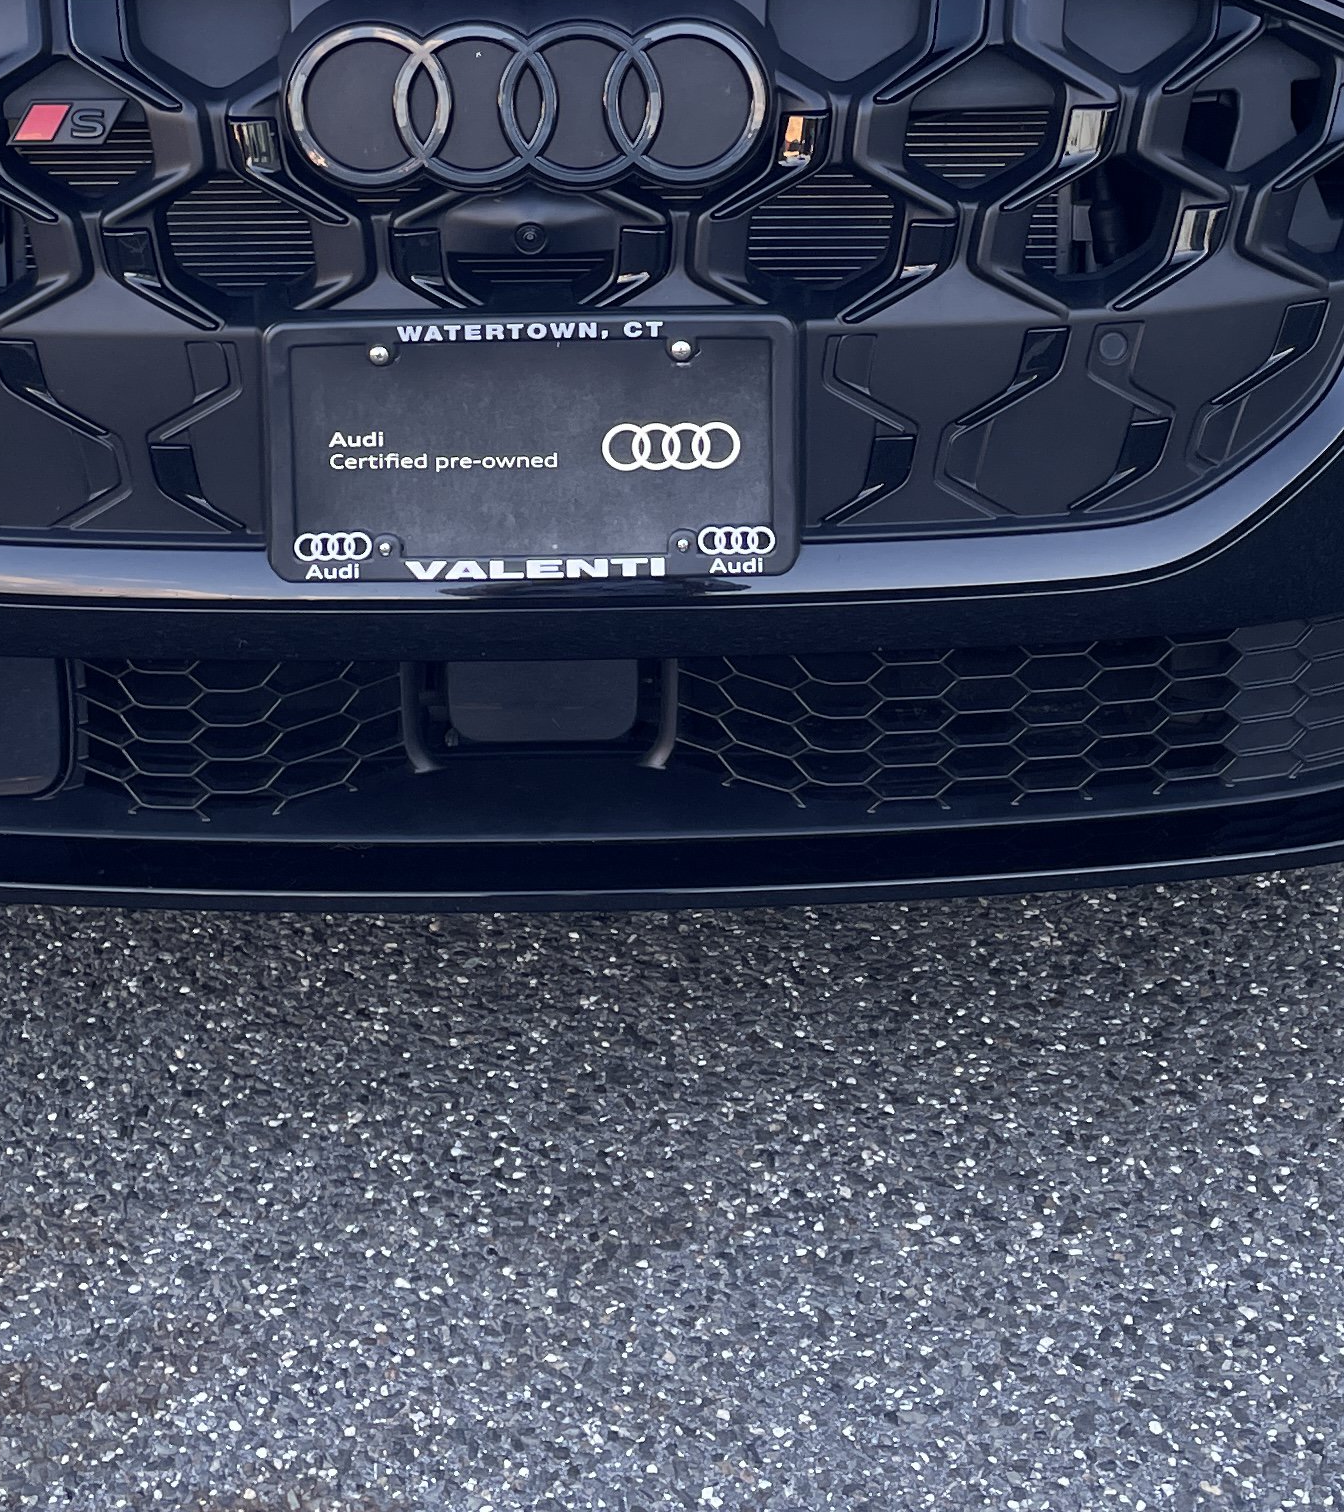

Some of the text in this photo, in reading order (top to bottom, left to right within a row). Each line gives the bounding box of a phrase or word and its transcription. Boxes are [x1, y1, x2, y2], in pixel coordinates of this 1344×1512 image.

[397, 321, 664, 342] WATERTOWN, CT
[329, 431, 384, 448] Audi
[329, 452, 558, 472] Certified pre-owned
[305, 563, 360, 580] Audi
[405, 557, 665, 580] VALENTI
[709, 557, 763, 574] Audi
